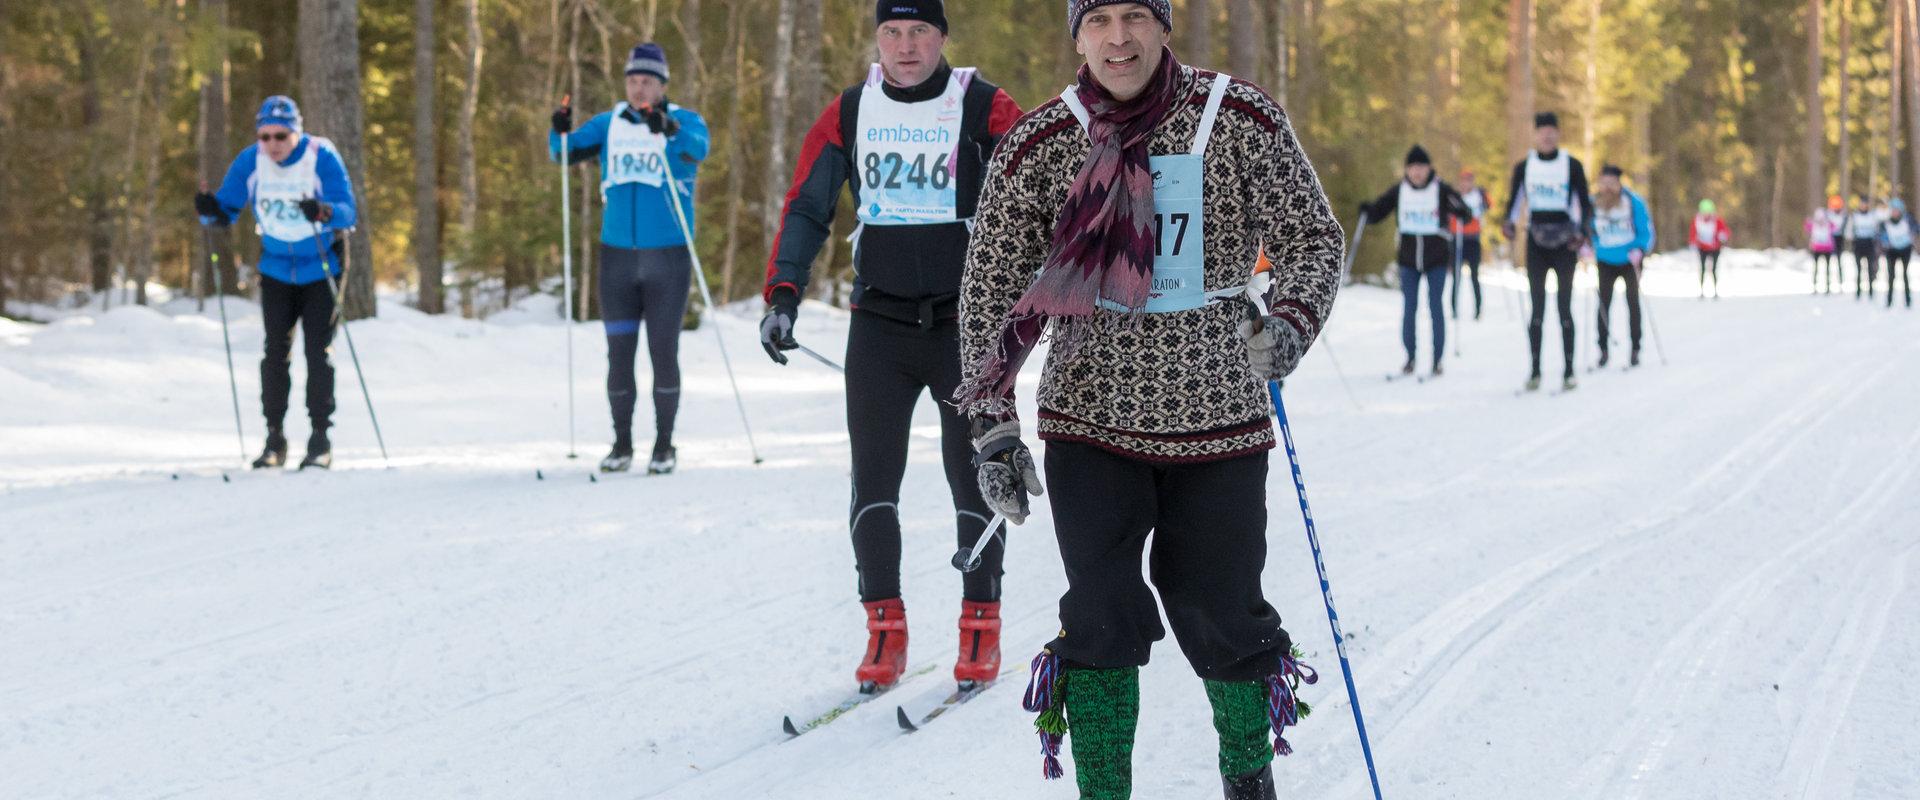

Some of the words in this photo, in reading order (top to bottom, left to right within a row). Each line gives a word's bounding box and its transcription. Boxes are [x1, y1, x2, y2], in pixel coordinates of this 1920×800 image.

[867, 123, 949, 143] embach
[613, 152, 659, 175] 1930
[864, 151, 950, 191] 8246
[1154, 212, 1190, 257] 17
